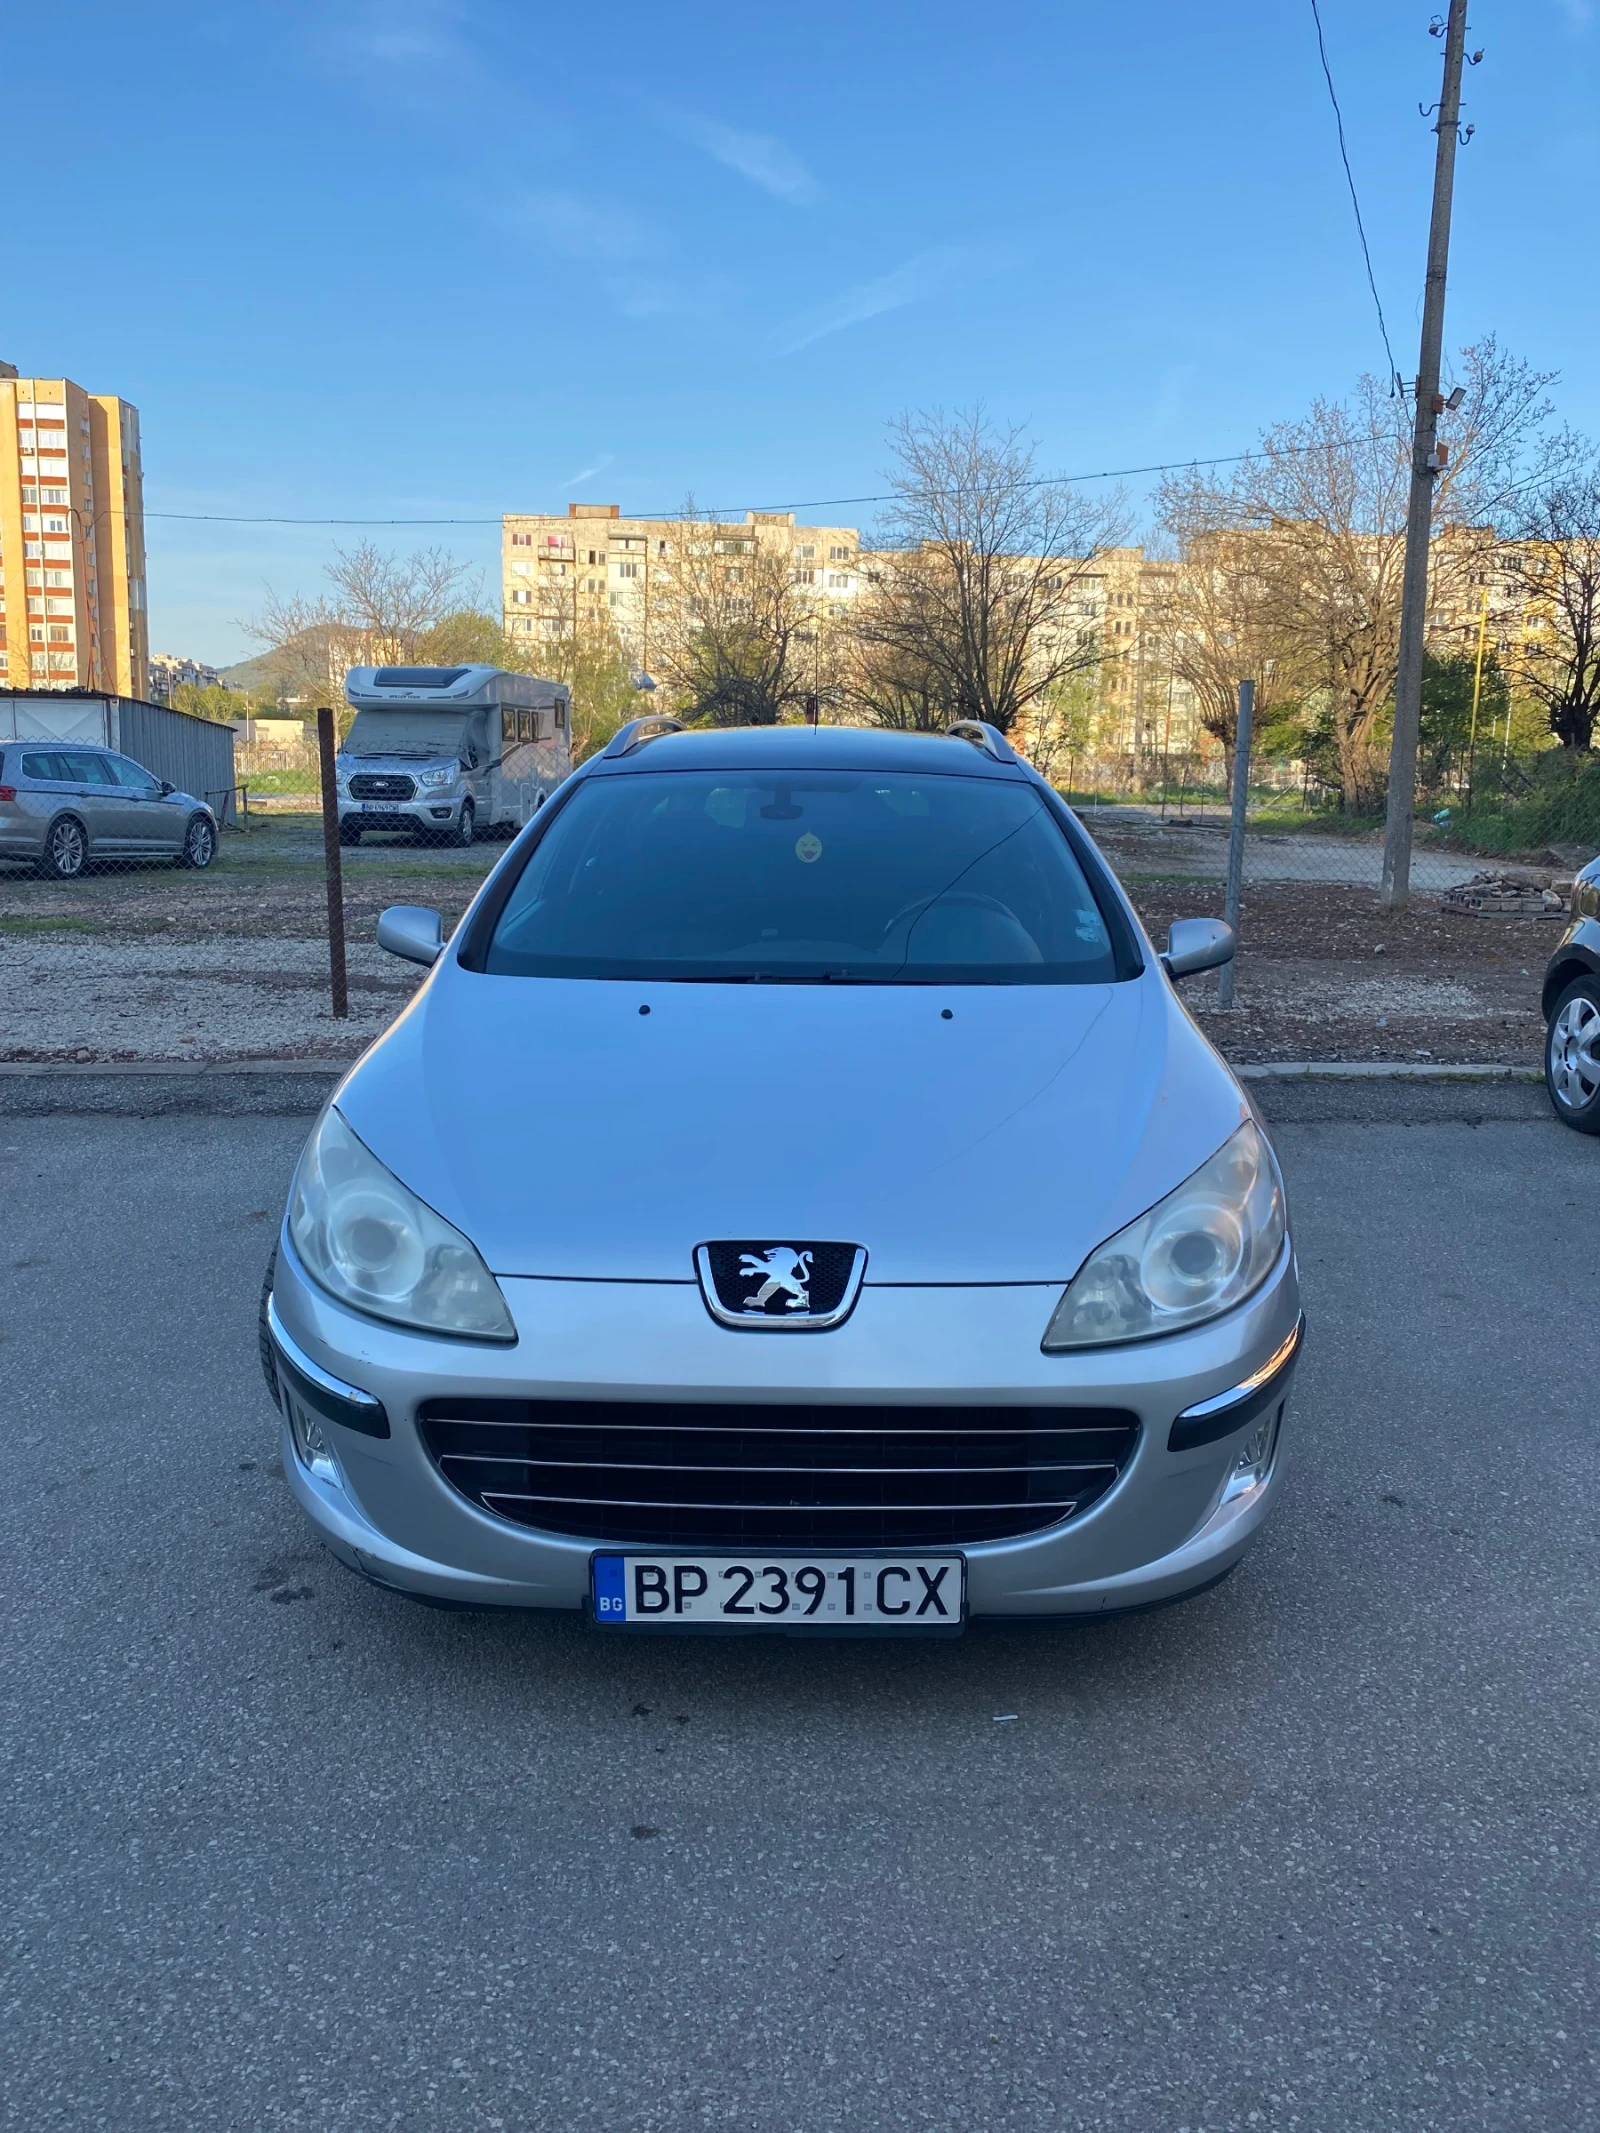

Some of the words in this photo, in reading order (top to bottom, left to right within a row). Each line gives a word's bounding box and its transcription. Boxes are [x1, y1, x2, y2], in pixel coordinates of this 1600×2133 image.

[600, 1597, 623, 1611] BG
[634, 1565, 708, 1614] BP
[723, 1566, 855, 1615] 2391
[876, 1566, 950, 1615] CX
